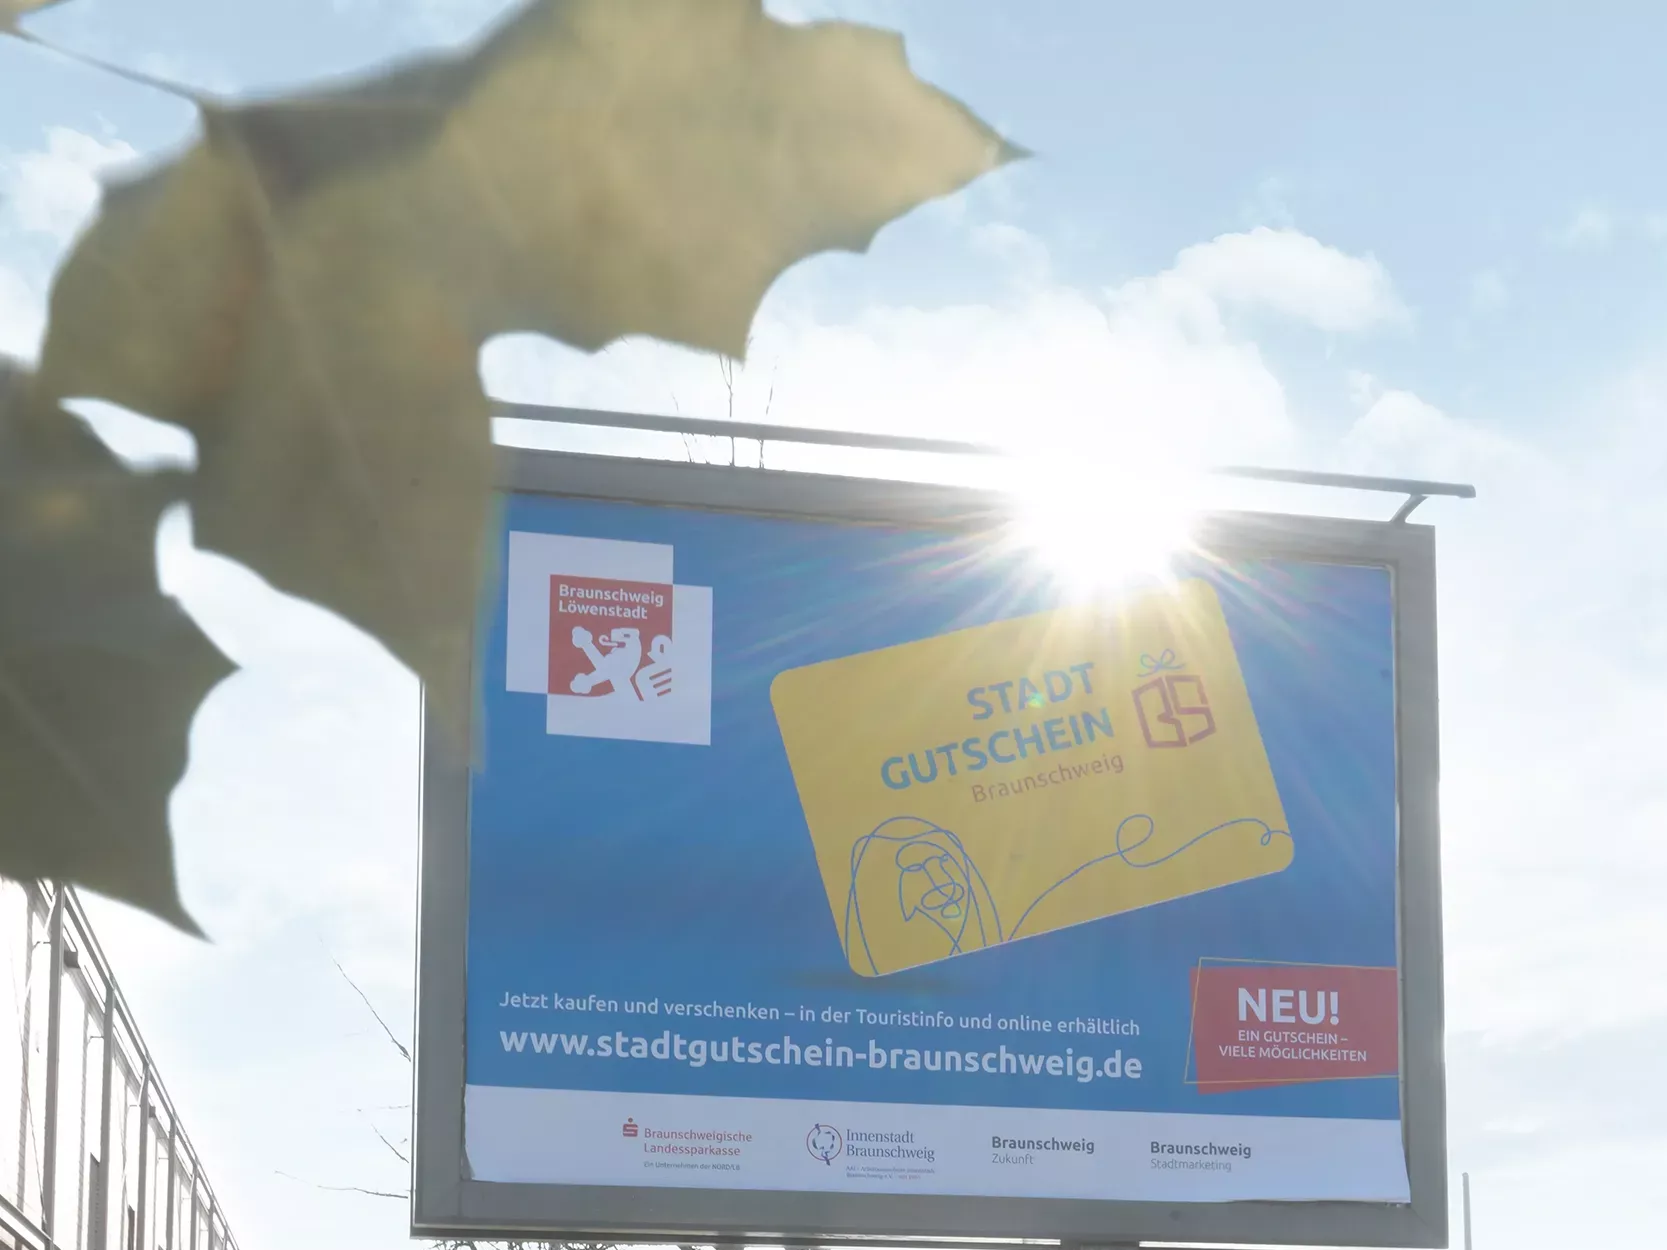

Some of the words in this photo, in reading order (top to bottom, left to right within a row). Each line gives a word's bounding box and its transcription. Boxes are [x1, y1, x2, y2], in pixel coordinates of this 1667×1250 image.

[559, 584, 664, 607] Braunschweig
[558, 600, 648, 620] Löwenstadt
[966, 662, 1095, 720] STADT
[880, 708, 1115, 790] GUTSCHEIN
[971, 752, 1125, 803] Braunschweig
[499, 992, 549, 1009] Jetzt
[554, 994, 618, 1013] kaufen
[625, 998, 658, 1014] und
[664, 1001, 779, 1020] verschenken
[800, 1005, 815, 1021] in
[821, 1007, 851, 1023] der
[856, 1009, 954, 1028] Touristinfo
[960, 1014, 992, 1030] und
[998, 1015, 1052, 1032] online
[1057, 1017, 1140, 1035] erhältlich
[1238, 987, 1340, 1026] NEU!
[1238, 1029, 1260, 1043] EIN
[1263, 1030, 1338, 1045] GUTSCHEIN
[500, 1030, 1143, 1083] www.stadtgutschein-braunschweig.de
[1219, 1045, 1256, 1058] VIELE
[1259, 1045, 1367, 1062] MÖGLICHKEITEN
[644, 1128, 752, 1143] Braunschweigische
[846, 1129, 915, 1144] Innenstadt
[644, 1143, 741, 1156] Landessparkasse
[846, 1144, 935, 1163] Braunschweig
[992, 1136, 1095, 1154] Braunschweig
[1150, 1141, 1252, 1159] Braunschweig
[991, 1153, 1034, 1165] Zukunft
[1150, 1158, 1232, 1173] Stadtmarketing
